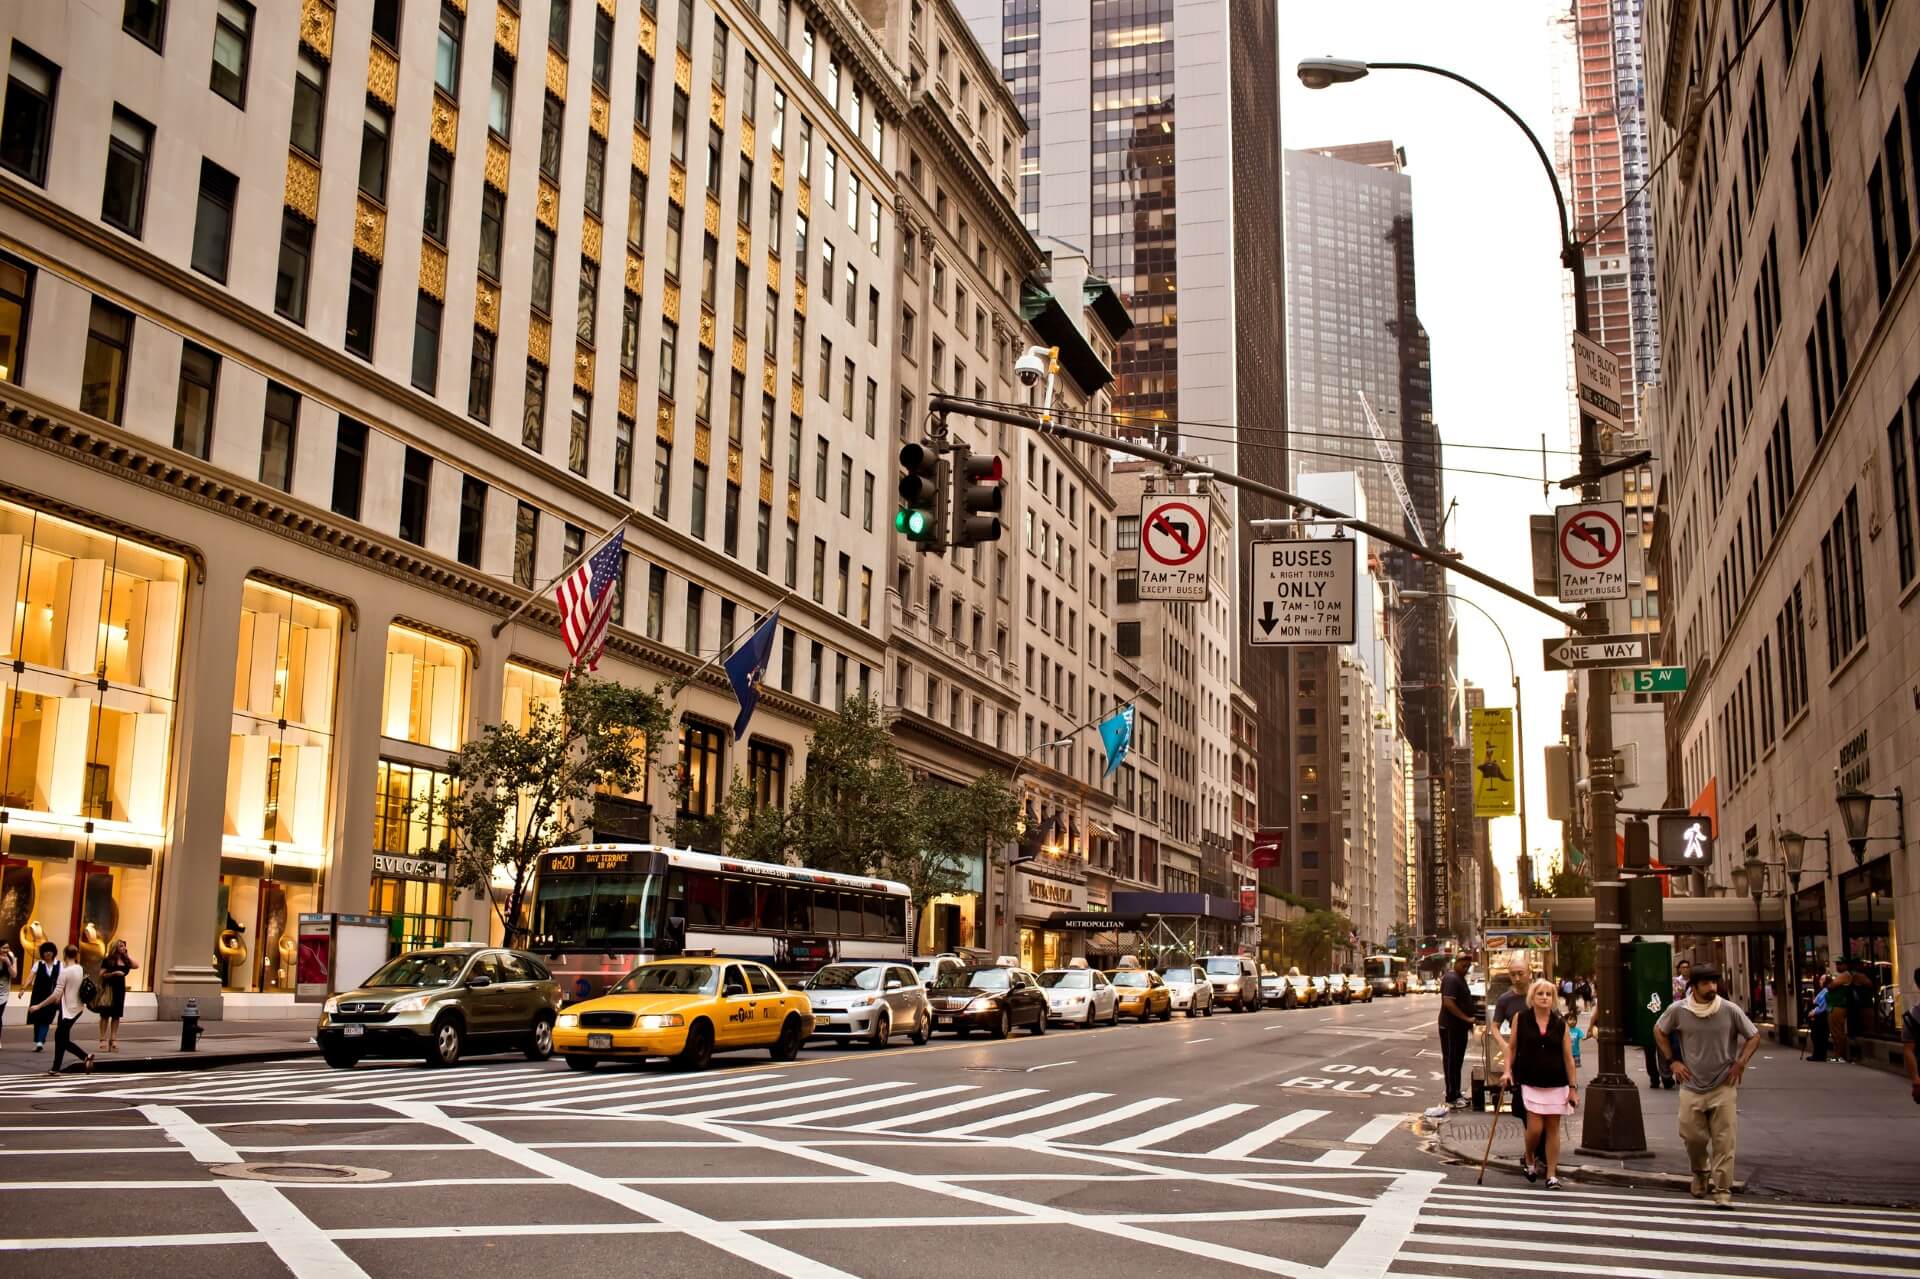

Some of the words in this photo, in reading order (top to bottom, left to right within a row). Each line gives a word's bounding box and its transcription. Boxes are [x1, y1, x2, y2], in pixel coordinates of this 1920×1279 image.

[1597, 355, 1617, 377] BLOCK
[1586, 365, 1598, 381] THE
[1599, 372, 1611, 391] BOX
[1272, 550, 1332, 567] BUSES
[1270, 571, 1276, 579] &
[1309, 570, 1335, 578] TURNS
[1142, 585, 1172, 594] EXCEPT
[1176, 586, 1203, 594] BUSES
[1277, 581, 1327, 598] ONLY
[1565, 588, 1593, 597] EXCEPT
[1596, 585, 1621, 594] BUSES
[1281, 626, 1300, 636] MON
[1304, 628, 1321, 636] THRU
[1325, 626, 1341, 636] FRI
[1560, 646, 1589, 660] ONE
[1604, 644, 1636, 657] WAY
[1640, 671, 1654, 689] 5
[1659, 670, 1672, 681] AV
[373, 856, 439, 878] BVLGAI
[1065, 920, 1124, 928] METROPOLITAN
[1276, 1076, 1425, 1097] BUS
